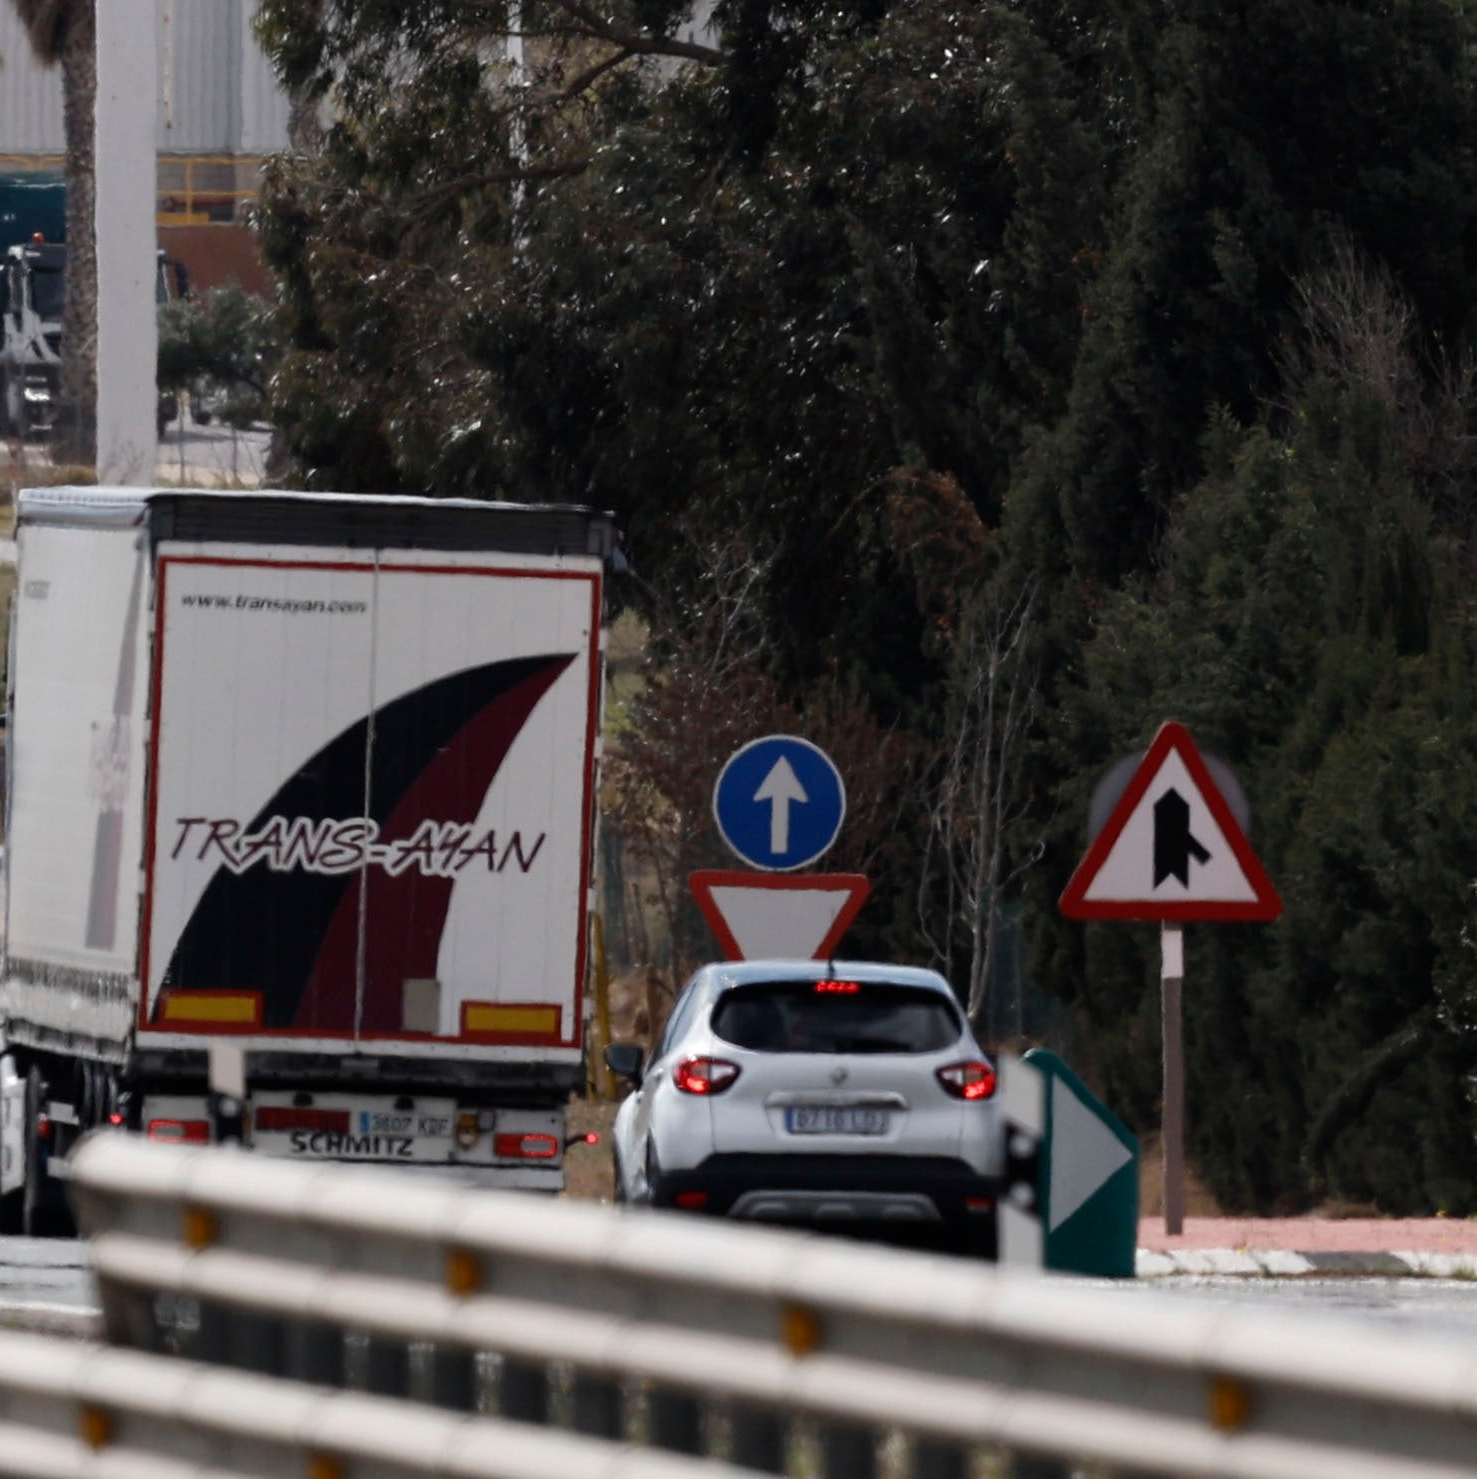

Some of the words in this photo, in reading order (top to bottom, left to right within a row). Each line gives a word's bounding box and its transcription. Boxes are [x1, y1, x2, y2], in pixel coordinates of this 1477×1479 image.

[181, 593, 367, 615] www.transayan.com
[170, 816, 547, 874] TRANS-AYAN
[290, 1130, 414, 1156] SCHMITZ
